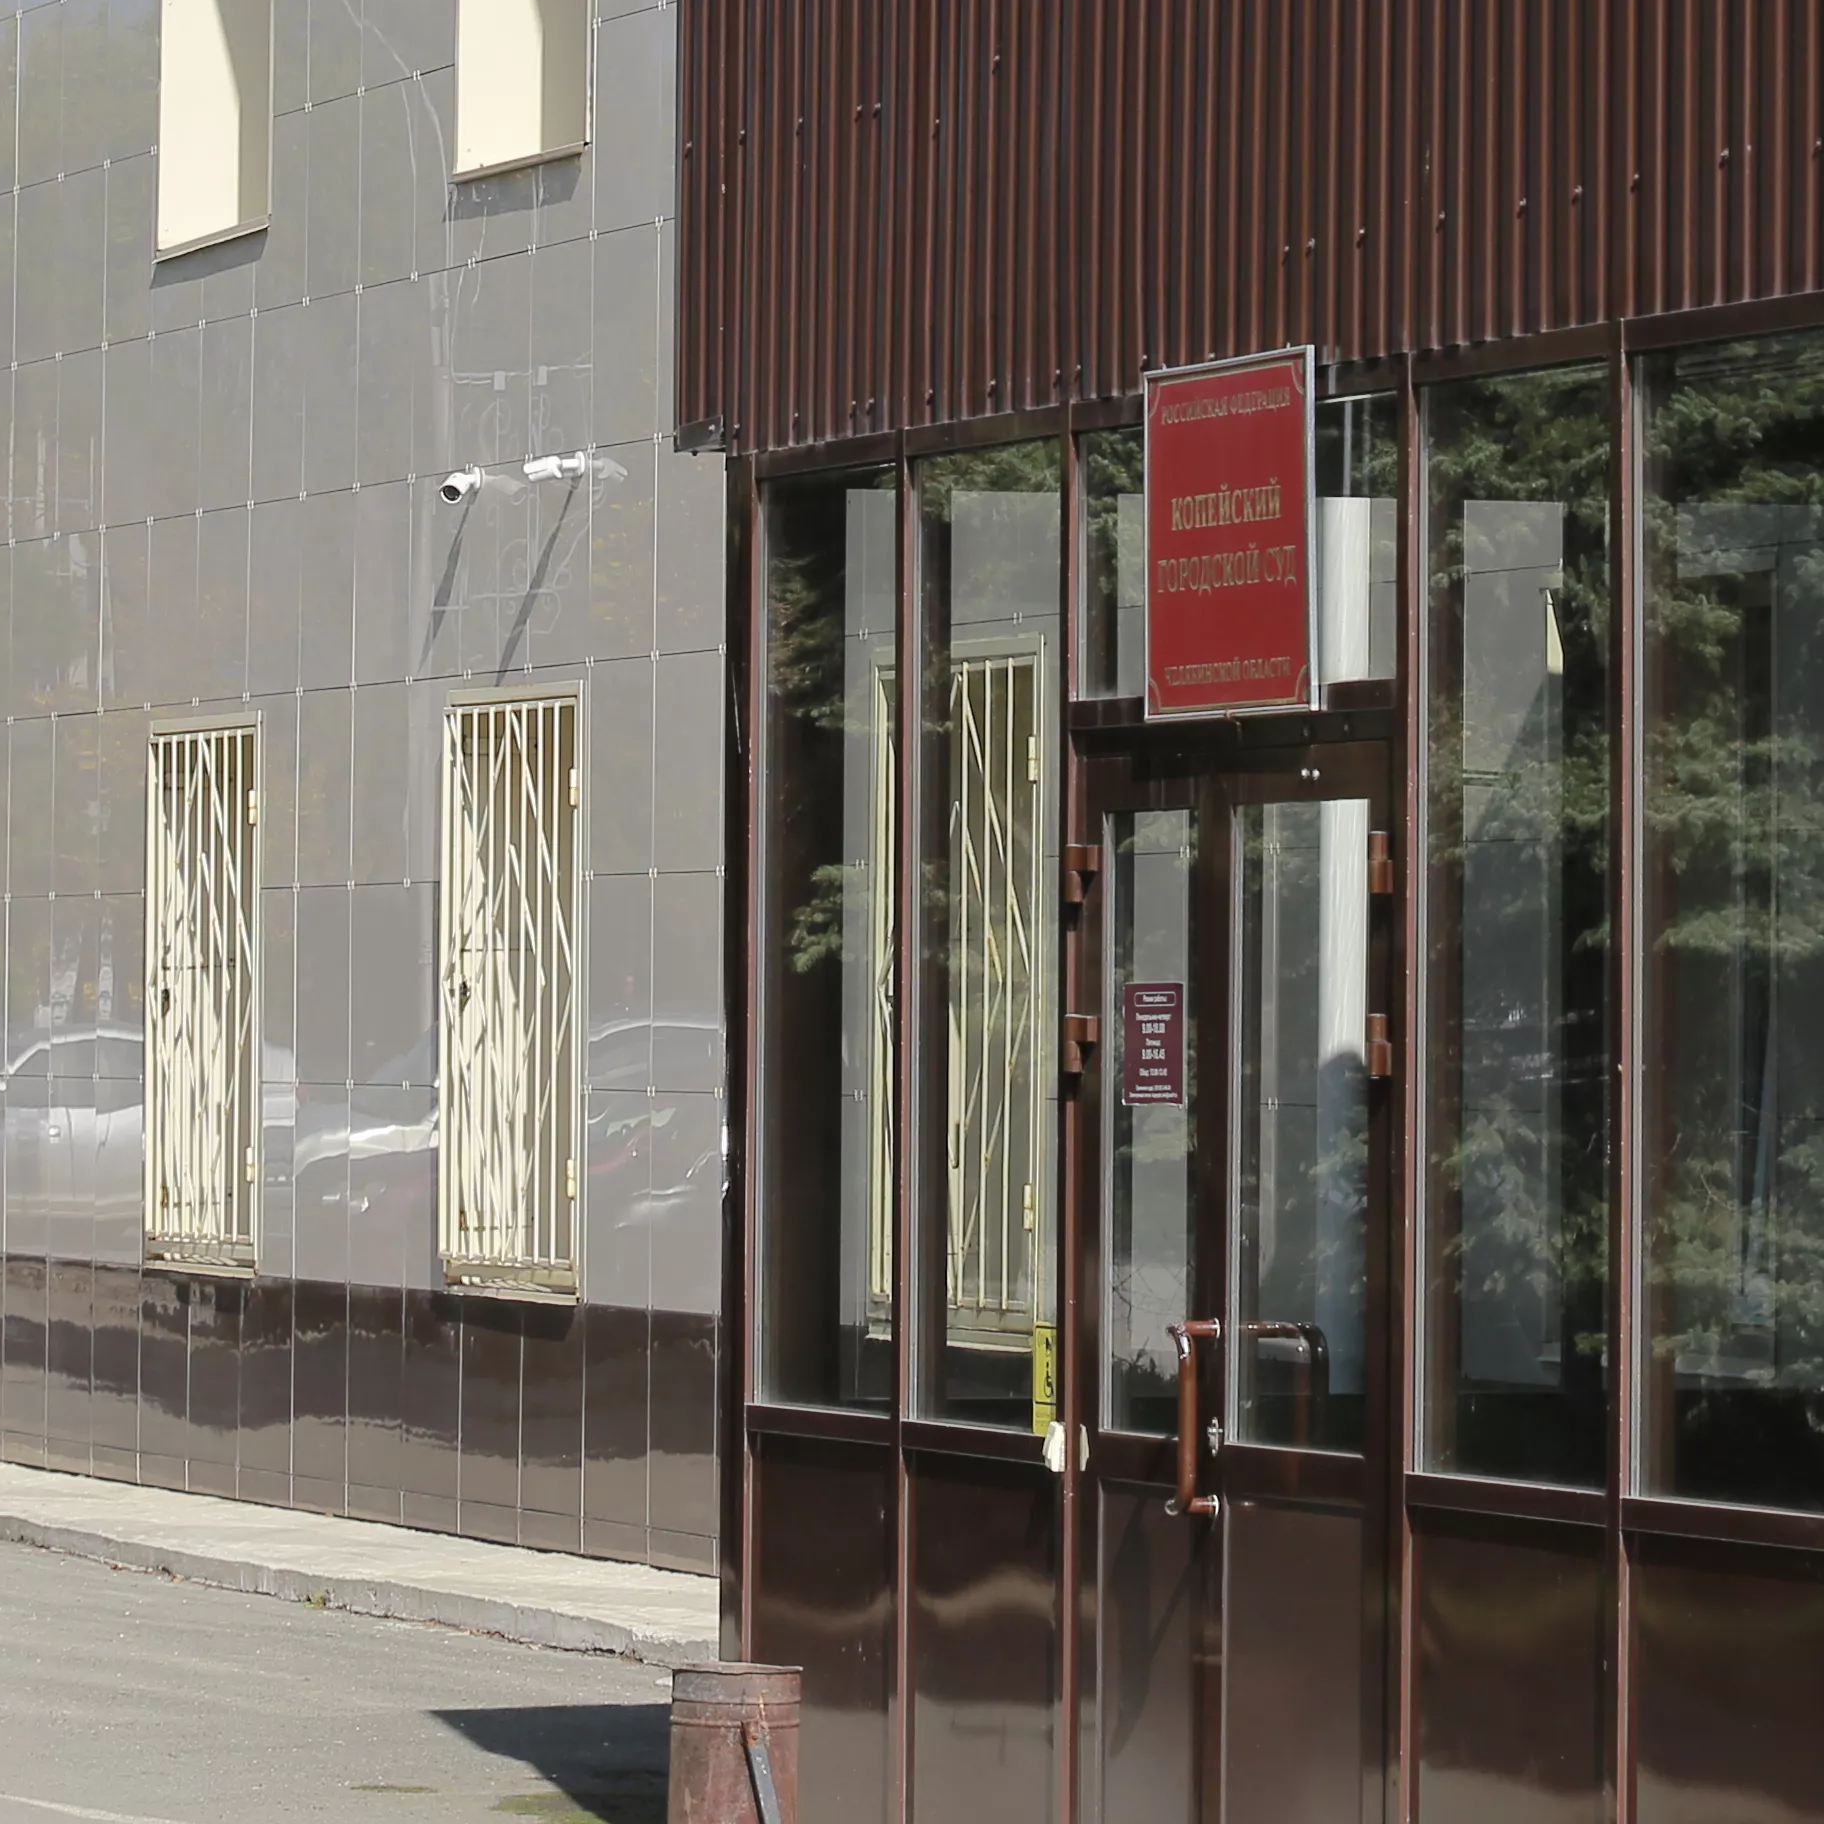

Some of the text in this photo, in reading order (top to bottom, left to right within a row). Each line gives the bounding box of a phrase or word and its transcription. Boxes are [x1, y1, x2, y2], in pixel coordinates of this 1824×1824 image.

[1171, 477, 1281, 531] КОПЕЙСКИЙ
[1158, 542, 1297, 597] ГОРОДСКОЙ СУД
[1243, 656, 1291, 680] ОБЛАСТИ
